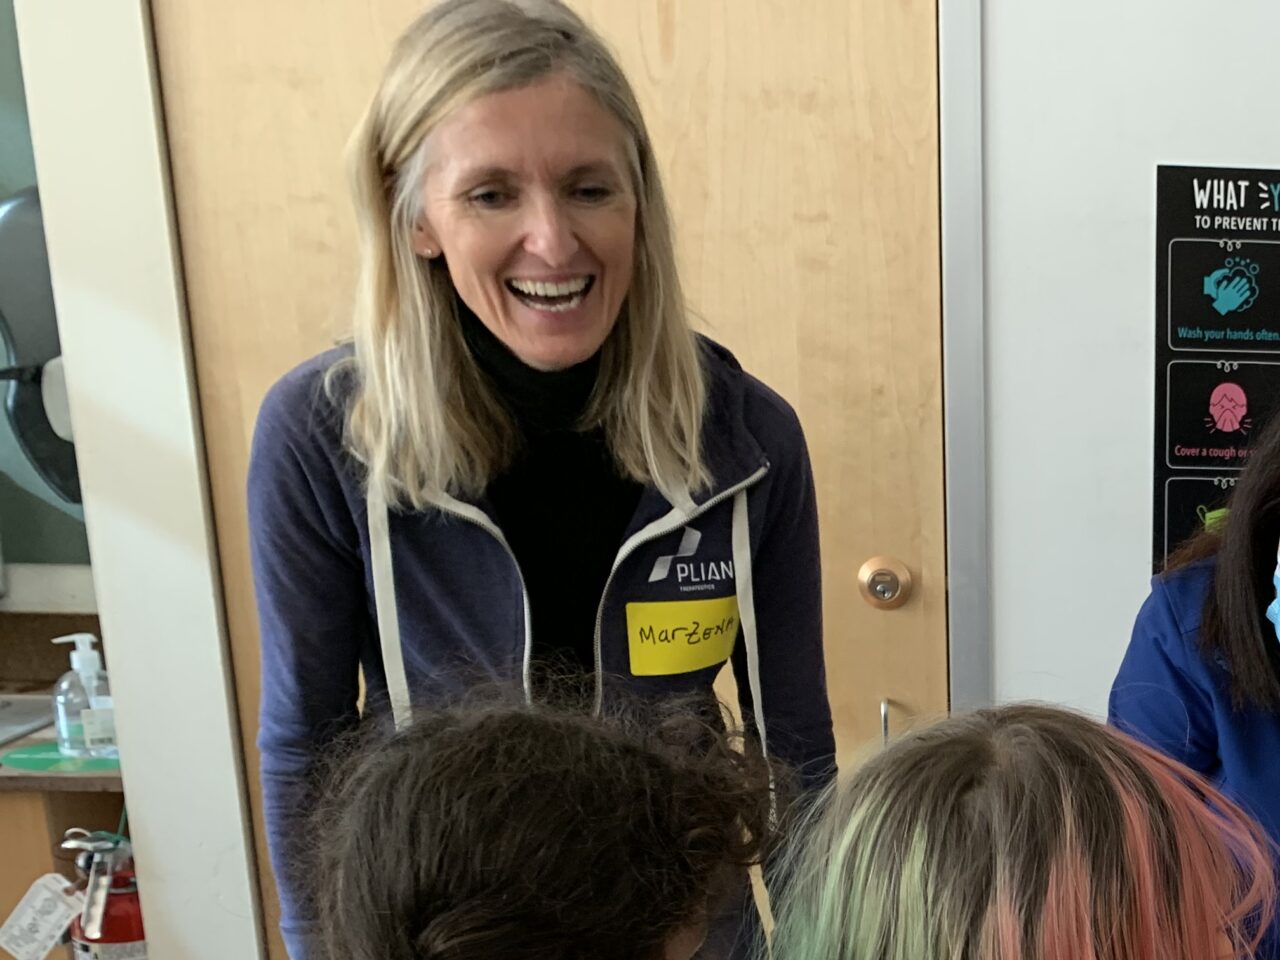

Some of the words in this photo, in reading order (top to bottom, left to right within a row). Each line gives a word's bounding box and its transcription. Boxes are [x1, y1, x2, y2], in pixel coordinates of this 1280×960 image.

[1193, 178, 1250, 210] WHAT
[1195, 215, 1210, 229] TO
[1214, 216, 1268, 232] PREVENT
[1177, 326, 1203, 338] Wash
[1204, 330, 1225, 342] your
[1226, 328, 1254, 340] hands
[1174, 444, 1200, 457] Cover
[1201, 448, 1207, 456] a
[1208, 446, 1236, 460] cough
[1237, 449, 1248, 457] or
[676, 560, 735, 583] PLIAN
